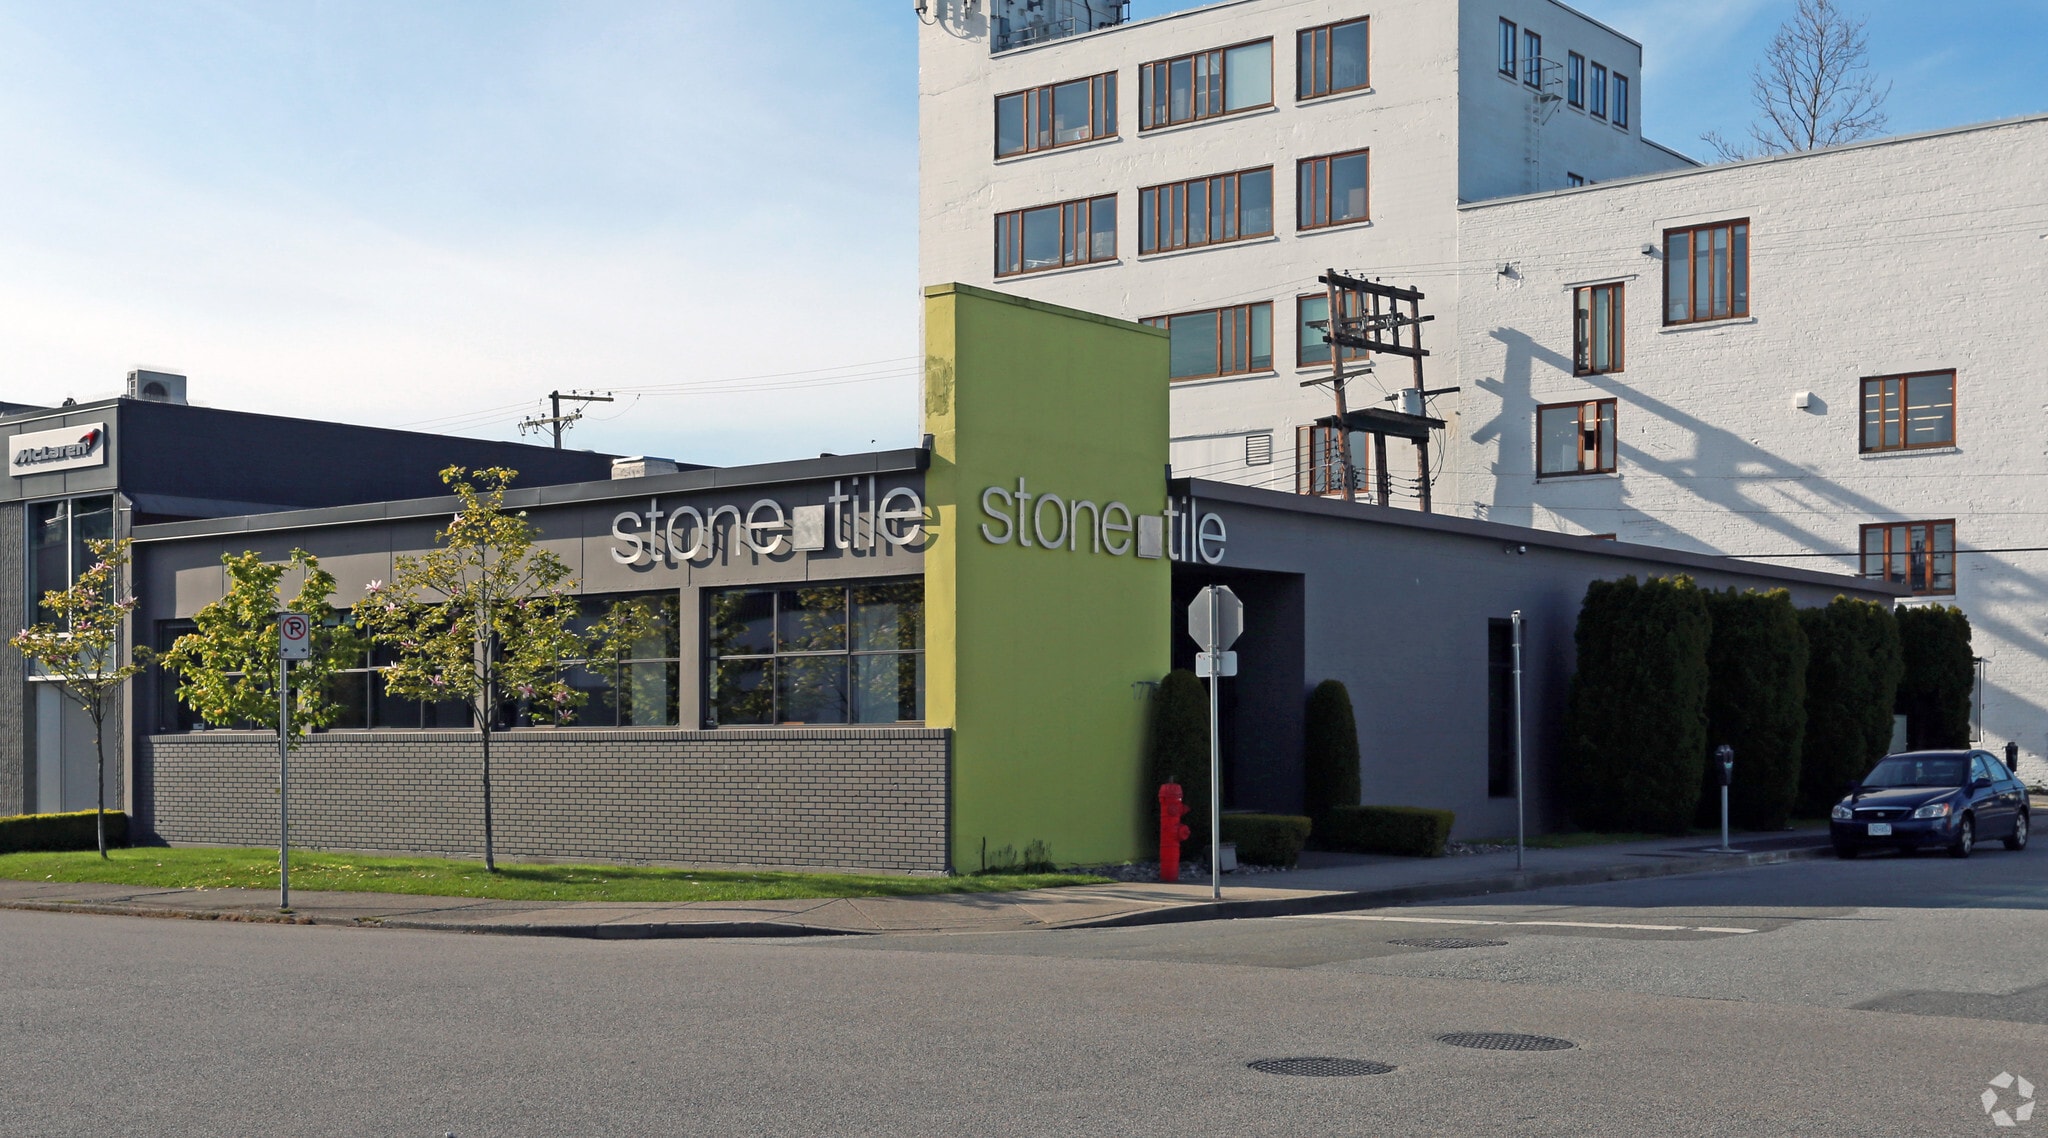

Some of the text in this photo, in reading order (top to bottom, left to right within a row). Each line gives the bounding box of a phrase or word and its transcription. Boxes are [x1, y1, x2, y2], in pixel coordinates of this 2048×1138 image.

[13, 442, 88, 465] McLaren
[611, 475, 923, 564] stone tile
[982, 477, 1227, 564] stone tile
